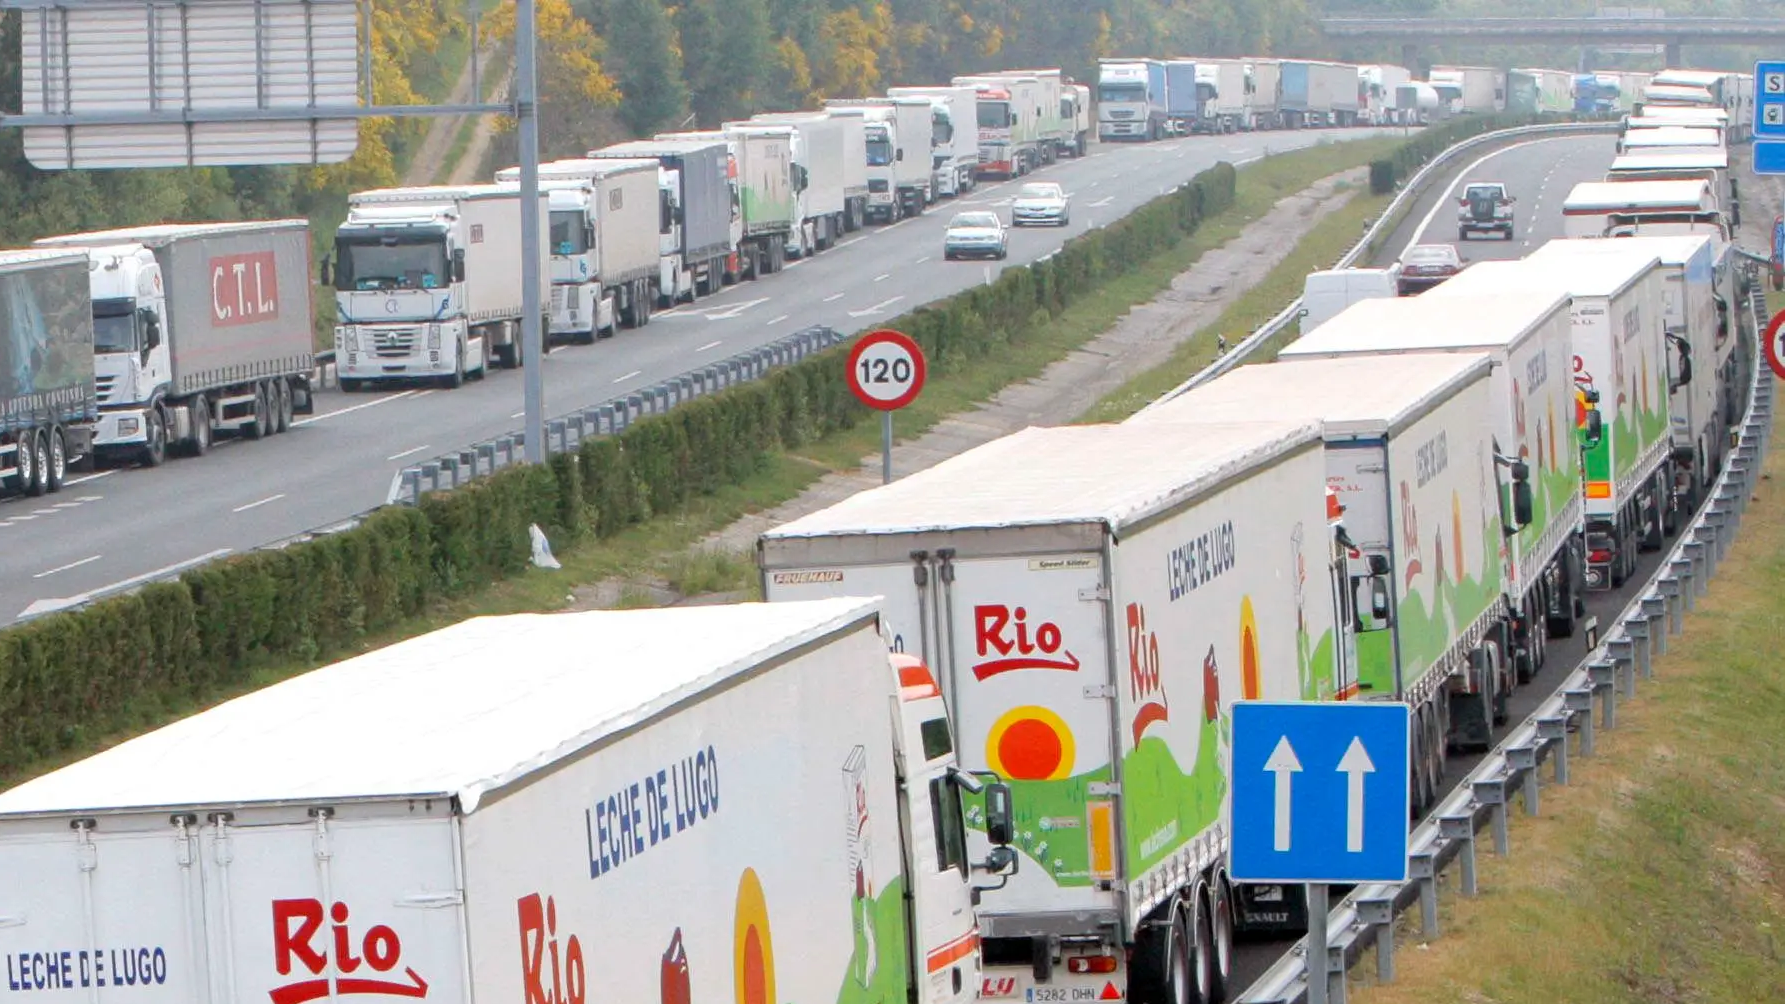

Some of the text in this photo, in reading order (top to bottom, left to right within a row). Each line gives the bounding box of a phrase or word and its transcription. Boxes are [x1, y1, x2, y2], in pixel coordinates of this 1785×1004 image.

[1769, 75, 1781, 91] S
[860, 358, 911, 383] 120
[775, 571, 843, 583] FRUEHAUF
[1167, 520, 1235, 602] LECHE DE LUGO
[974, 604, 1062, 657] Rio
[1126, 602, 1160, 703] Rio
[585, 744, 719, 880] LECHE DE LUGO
[272, 897, 401, 975] Rio
[7, 946, 166, 991] LECHE DE LUGO
[1036, 987, 1095, 1001] 5282 DHN
